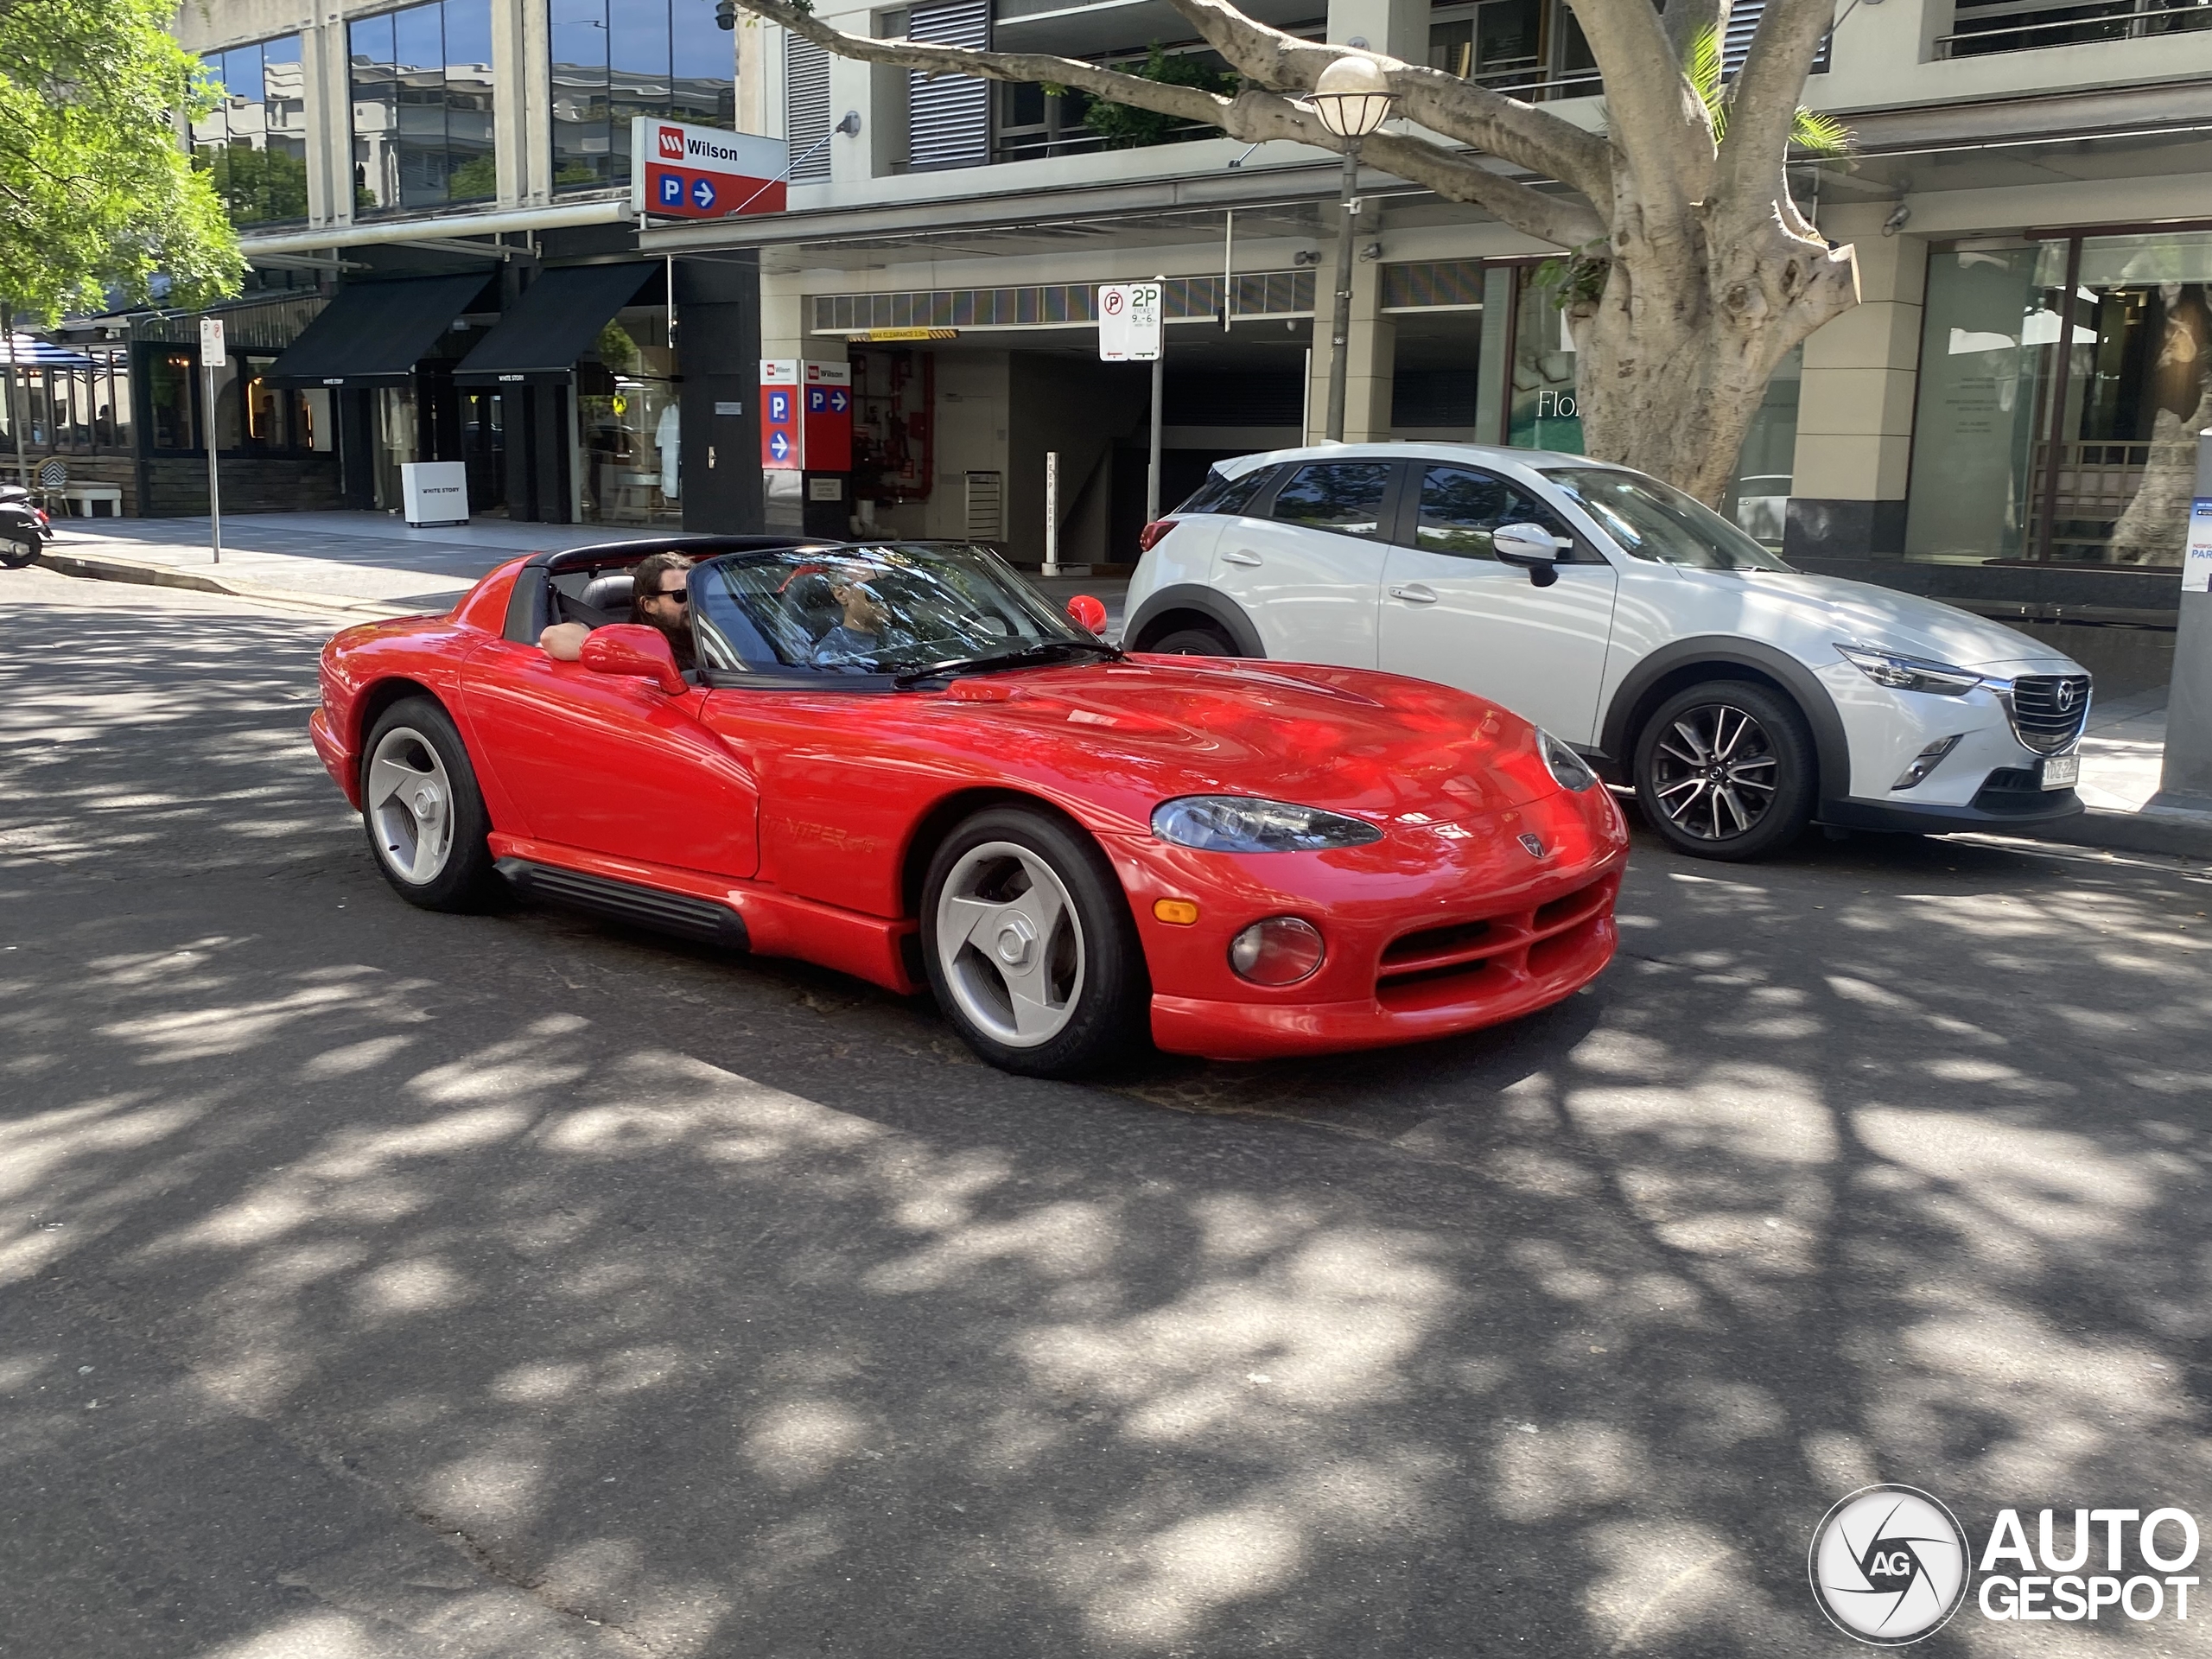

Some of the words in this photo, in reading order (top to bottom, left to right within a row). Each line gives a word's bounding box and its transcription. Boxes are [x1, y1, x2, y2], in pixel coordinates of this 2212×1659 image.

[687, 138, 738, 162] Wilson
[664, 179, 680, 200] P
[1132, 289, 1157, 307] 2P
[772, 397, 785, 418] P
[812, 392, 823, 409] P
